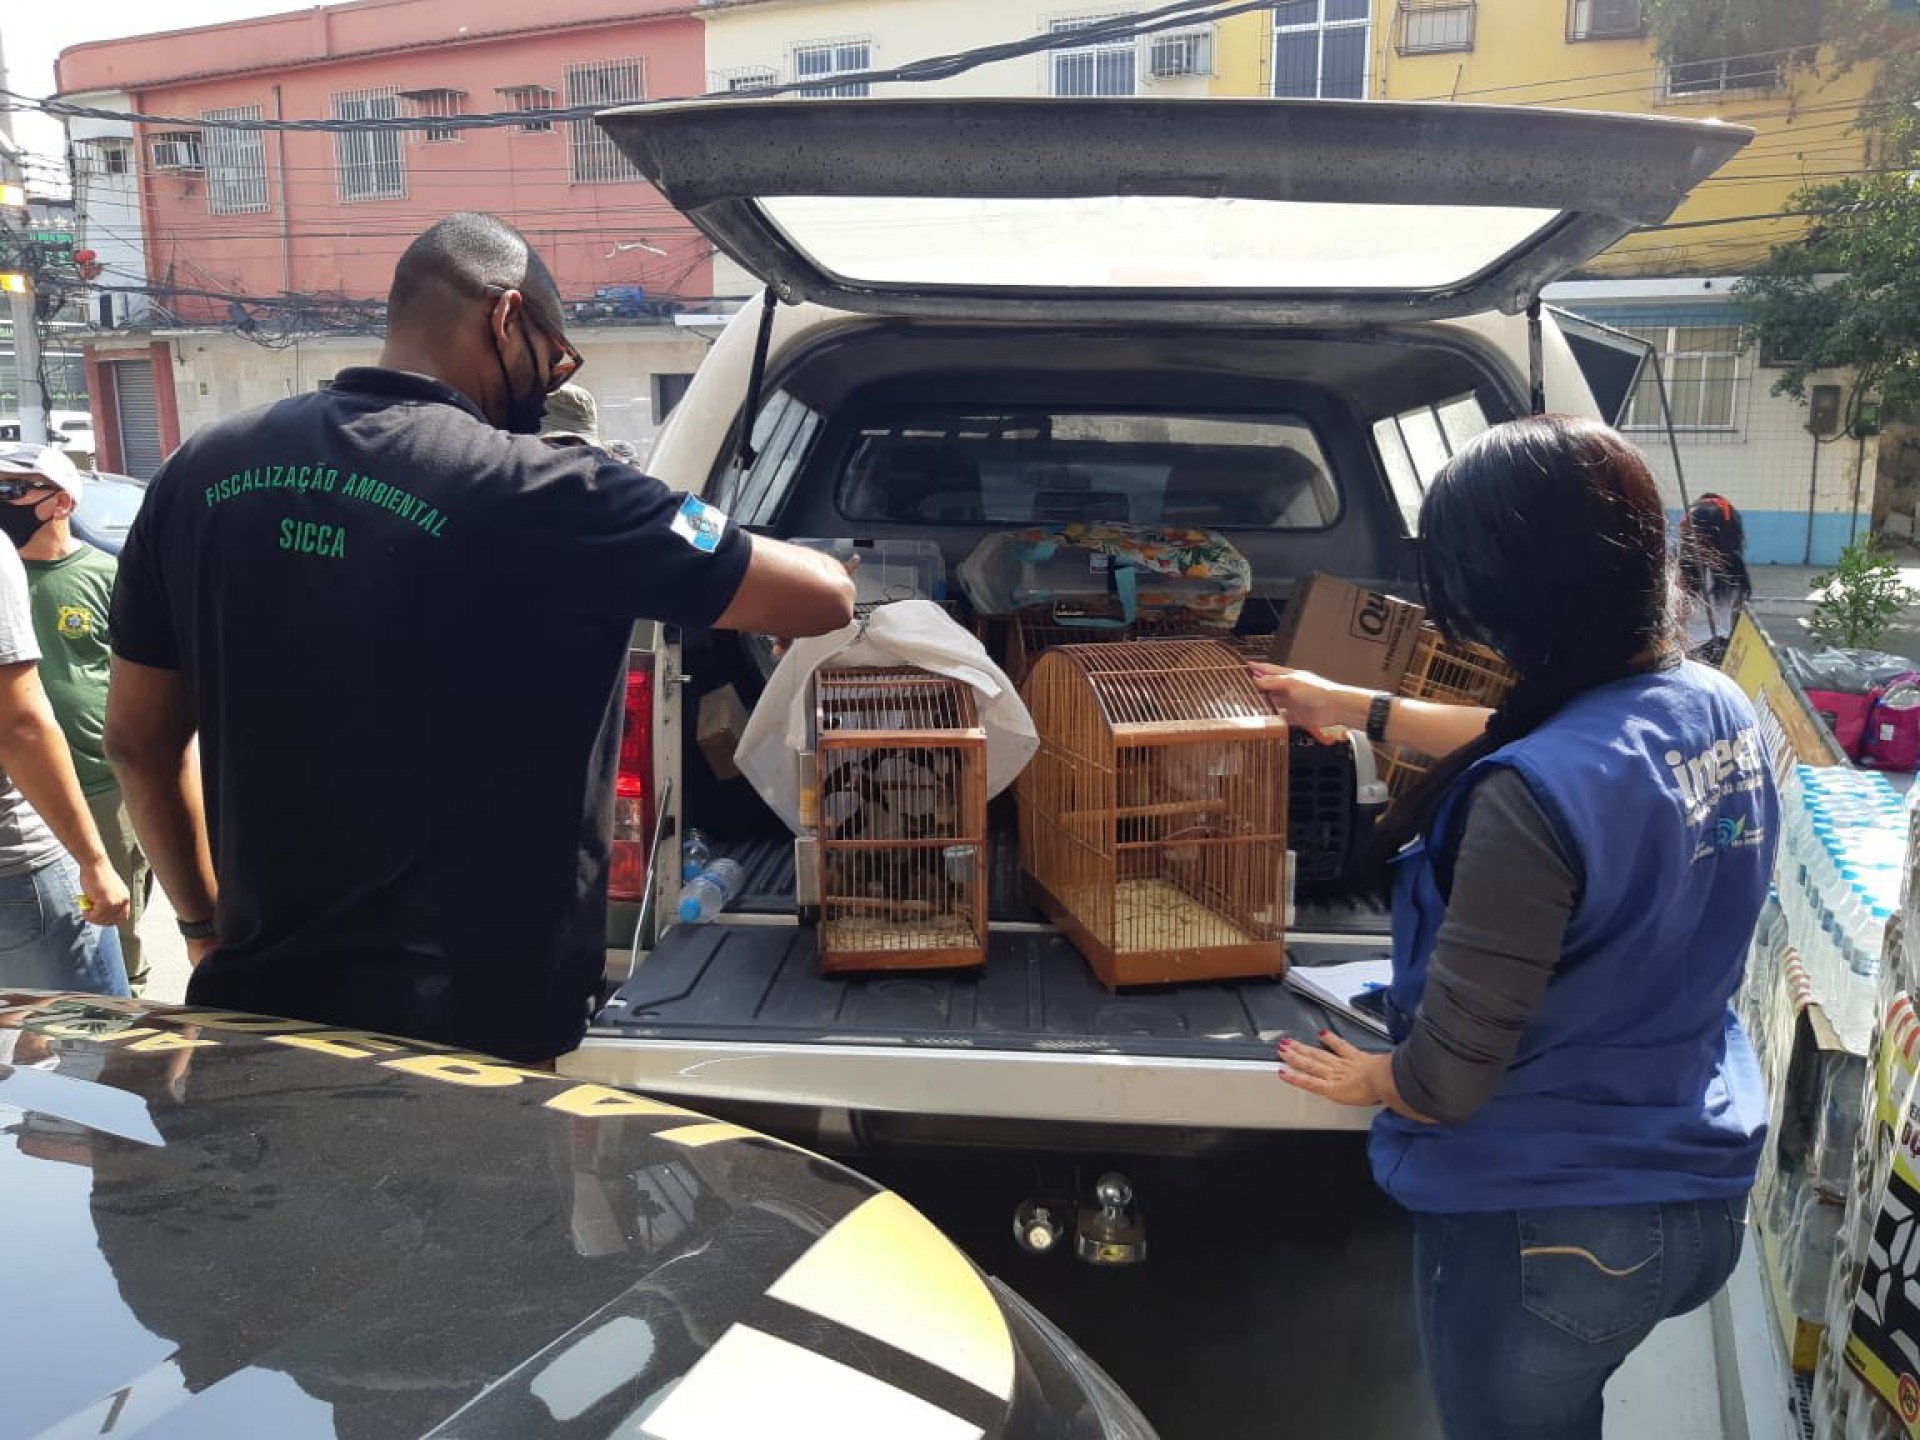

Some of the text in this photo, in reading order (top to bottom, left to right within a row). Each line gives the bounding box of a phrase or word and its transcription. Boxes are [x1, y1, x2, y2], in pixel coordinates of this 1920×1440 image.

[205, 462, 448, 538] FISCALIZAÇÃO AMBIENTAL
[279, 517, 346, 558] SICCA
